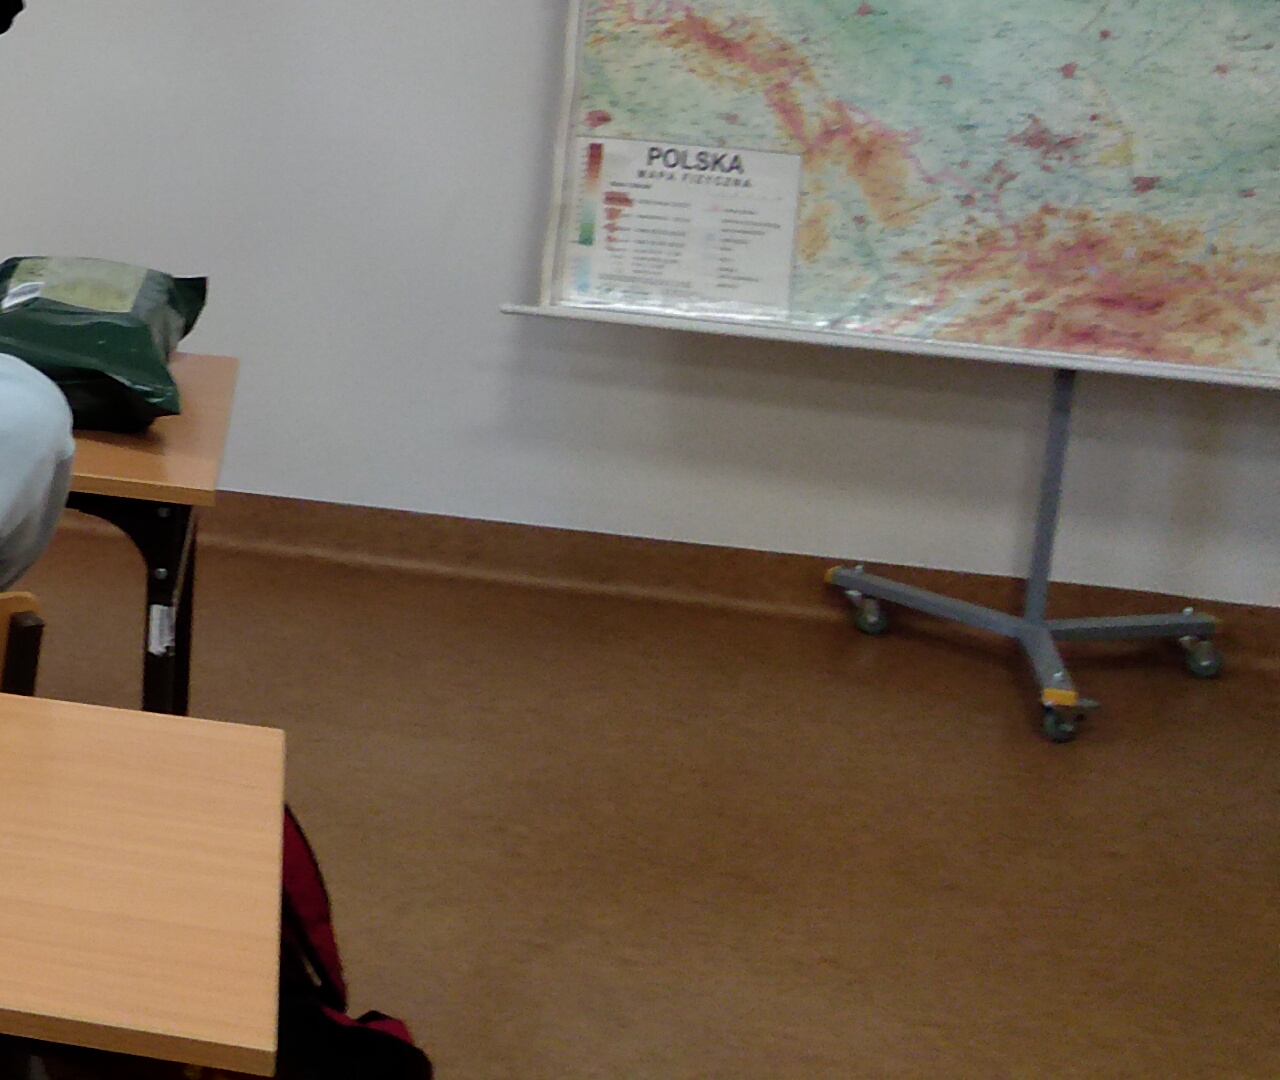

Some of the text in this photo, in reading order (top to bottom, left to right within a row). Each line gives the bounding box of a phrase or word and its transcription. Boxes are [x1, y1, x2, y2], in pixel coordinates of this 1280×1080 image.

[647, 147, 744, 174] POLSKA
[637, 169, 752, 188] MAPA FIZYCZNA
